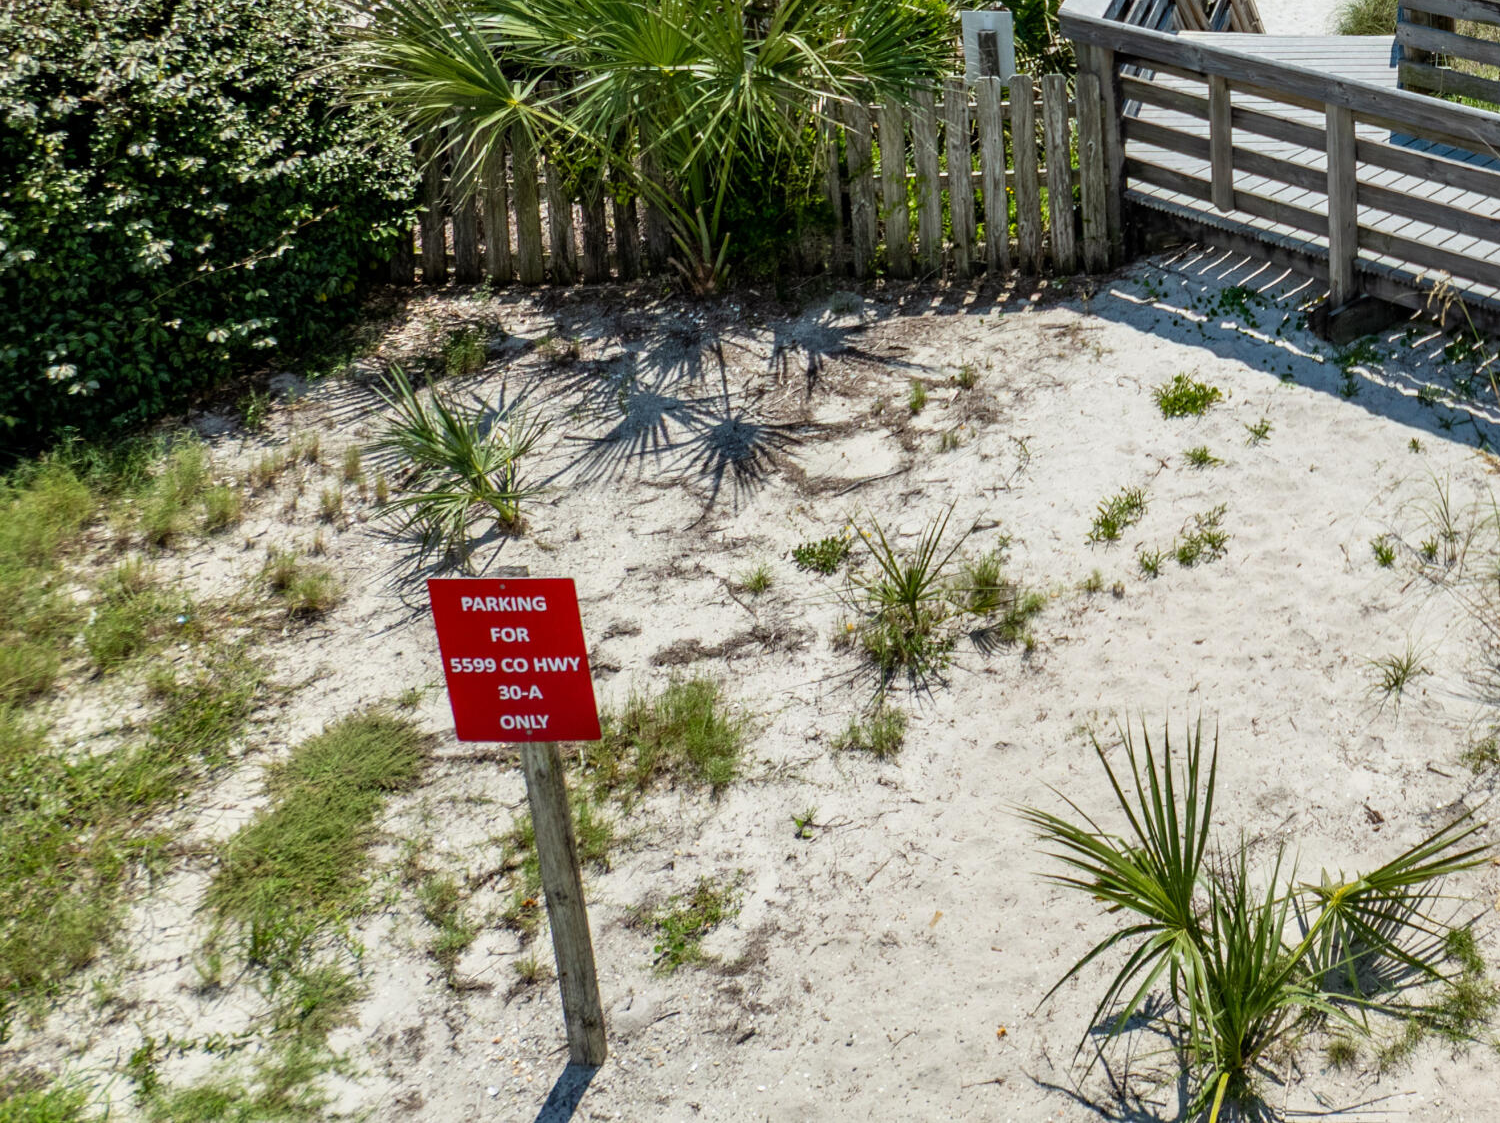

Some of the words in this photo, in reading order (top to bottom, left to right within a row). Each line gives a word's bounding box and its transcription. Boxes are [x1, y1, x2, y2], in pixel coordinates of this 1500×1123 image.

[461, 597, 547, 611] PARKING
[490, 628, 530, 642] FOR
[450, 658, 496, 673] 5599
[501, 658, 528, 672] CO
[533, 657, 580, 672] HWY
[498, 685, 543, 700] 30-A
[500, 715, 548, 729] ONLY
